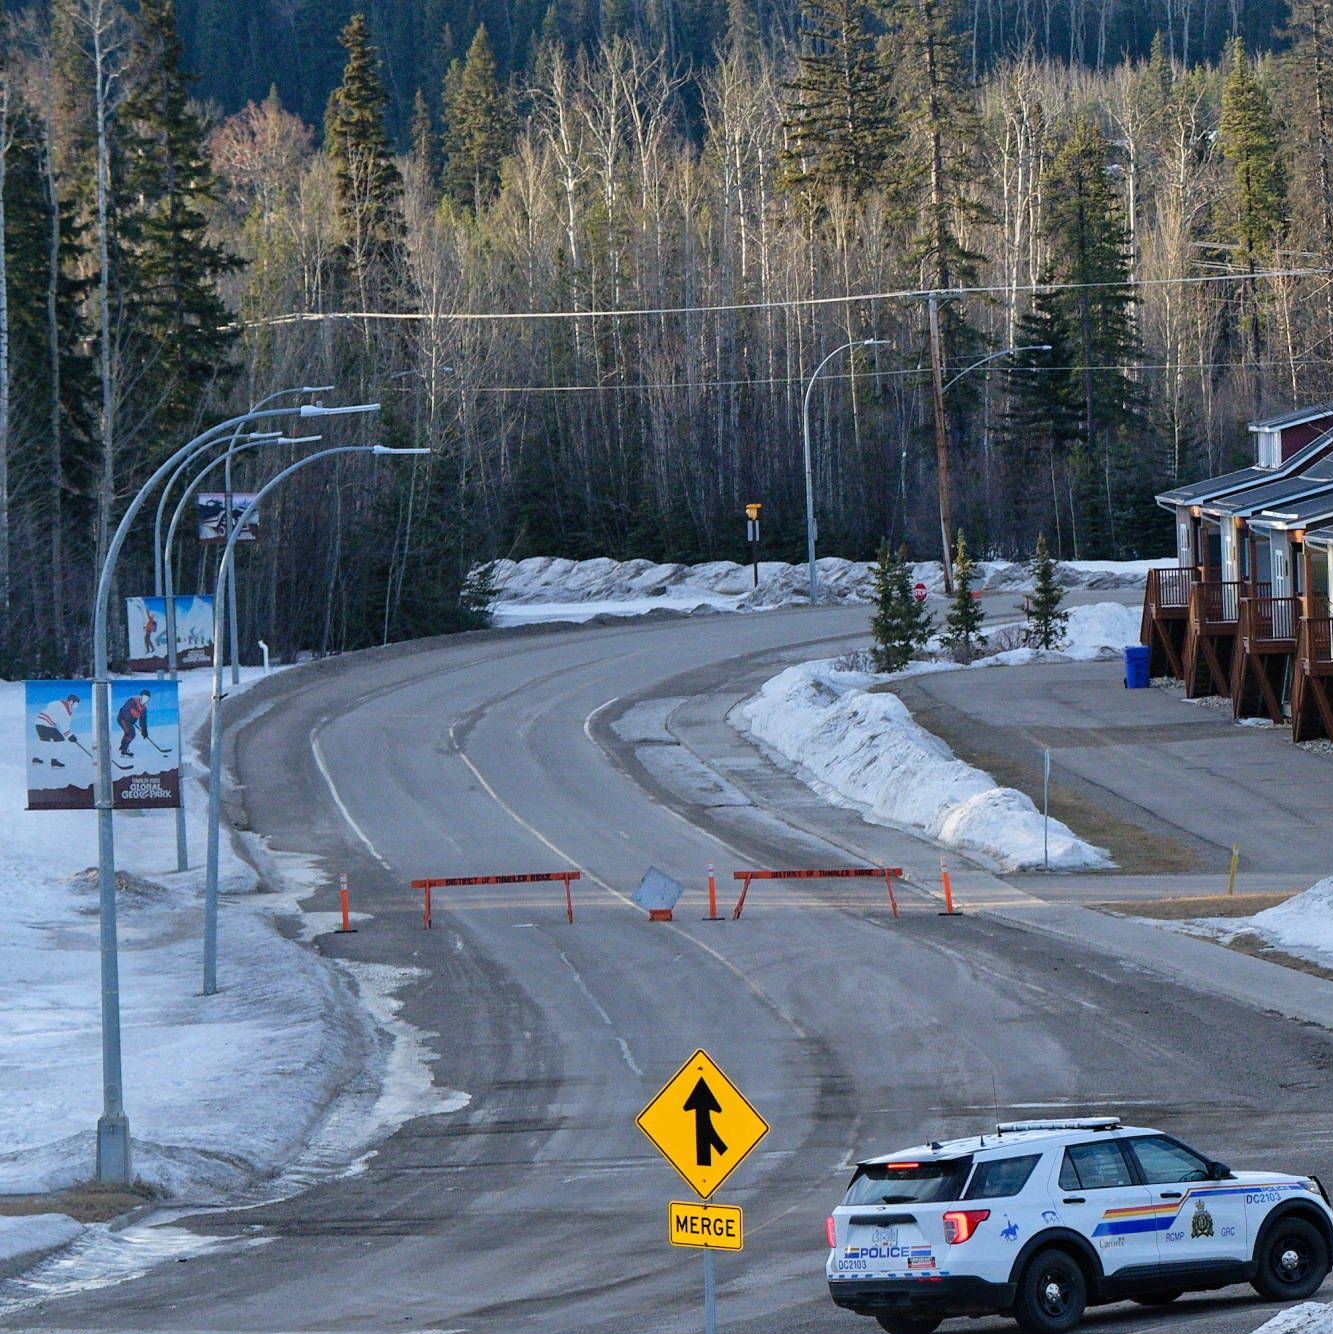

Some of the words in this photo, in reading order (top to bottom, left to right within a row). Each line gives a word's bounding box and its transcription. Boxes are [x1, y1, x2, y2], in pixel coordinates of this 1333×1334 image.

[1246, 1193, 1281, 1204] DC2103
[676, 1215, 736, 1237] MERGE
[1166, 1232, 1185, 1242] RCMP
[1220, 1227, 1236, 1237] GRC
[860, 1247, 910, 1259] POLICE
[838, 1260, 867, 1270] DC2103
